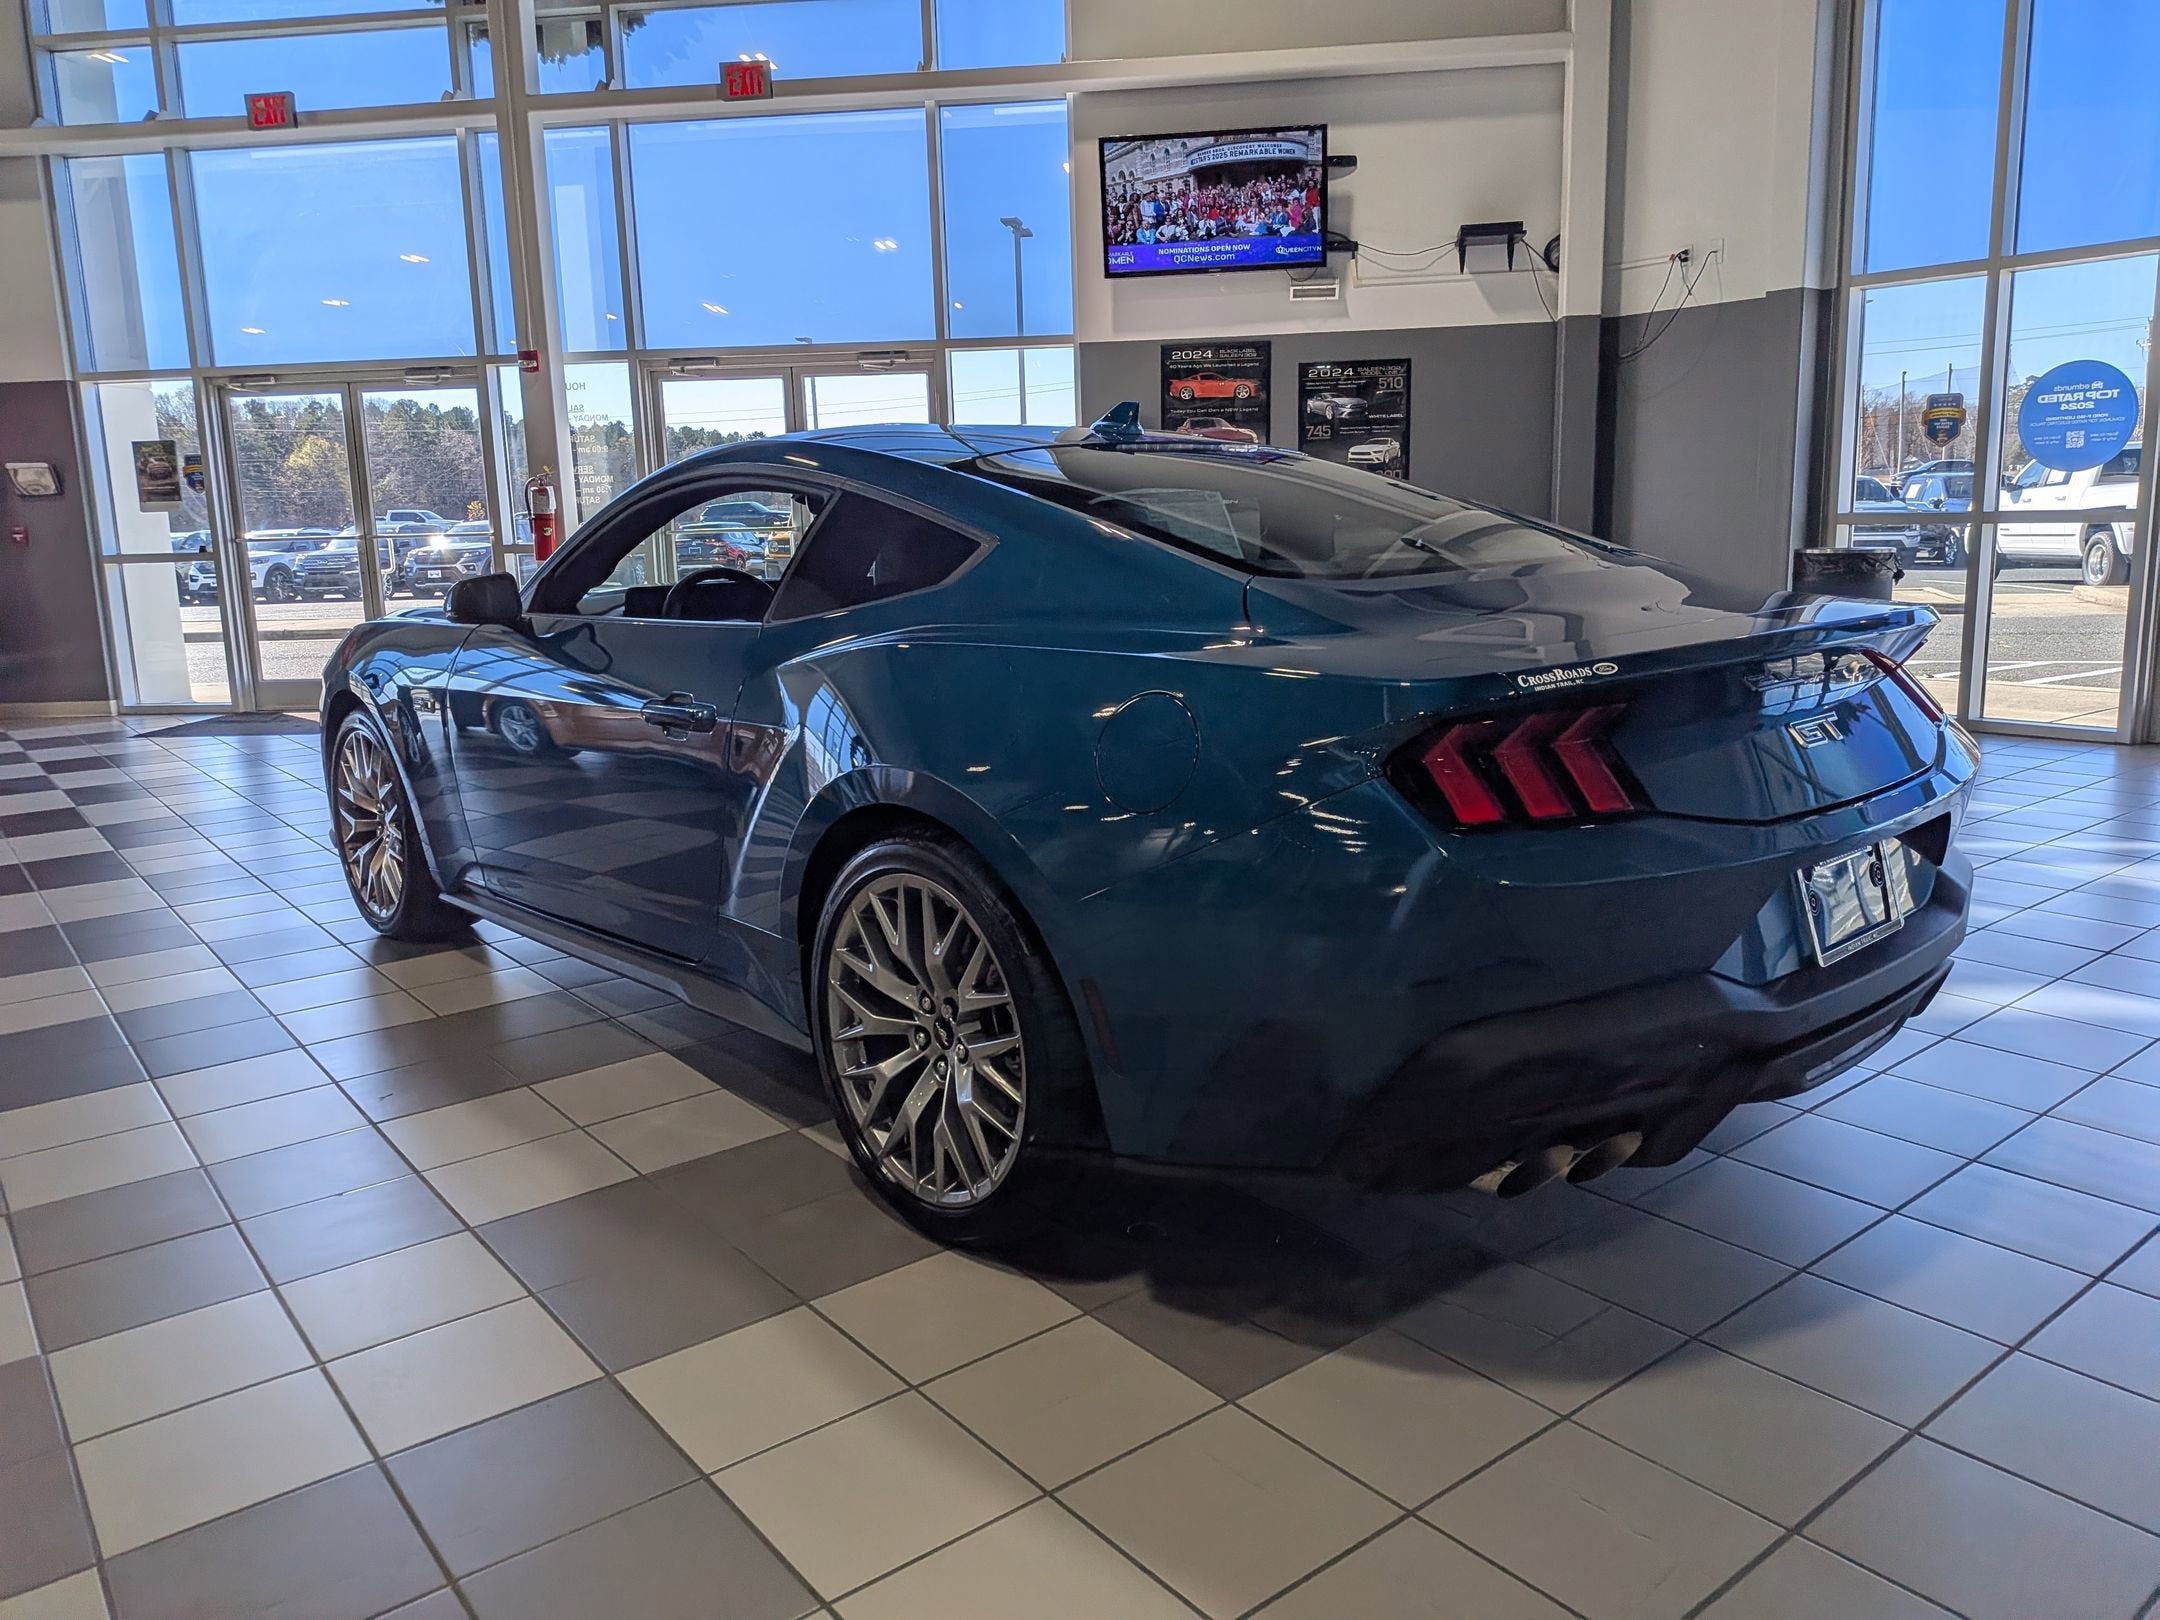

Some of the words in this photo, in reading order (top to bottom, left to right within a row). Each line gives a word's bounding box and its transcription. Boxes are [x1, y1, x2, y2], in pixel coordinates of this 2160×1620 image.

[727, 64, 764, 97] EXIT
[252, 96, 286, 127] EXIT
[1212, 152, 1228, 161] 2025
[1229, 148, 1277, 158] REMARKABLE
[1158, 246, 1210, 255] NOMINATIONS
[1232, 243, 1251, 251] NOW
[1173, 253, 1236, 264] QCNews.com
[1171, 350, 1213, 360] 2024
[1308, 368, 1354, 378] 2024
[1379, 377, 1404, 389] 510
[1306, 425, 1331, 437] 745
[1534, 683, 1556, 692] INDIAN
[1788, 711, 1843, 748] GT
